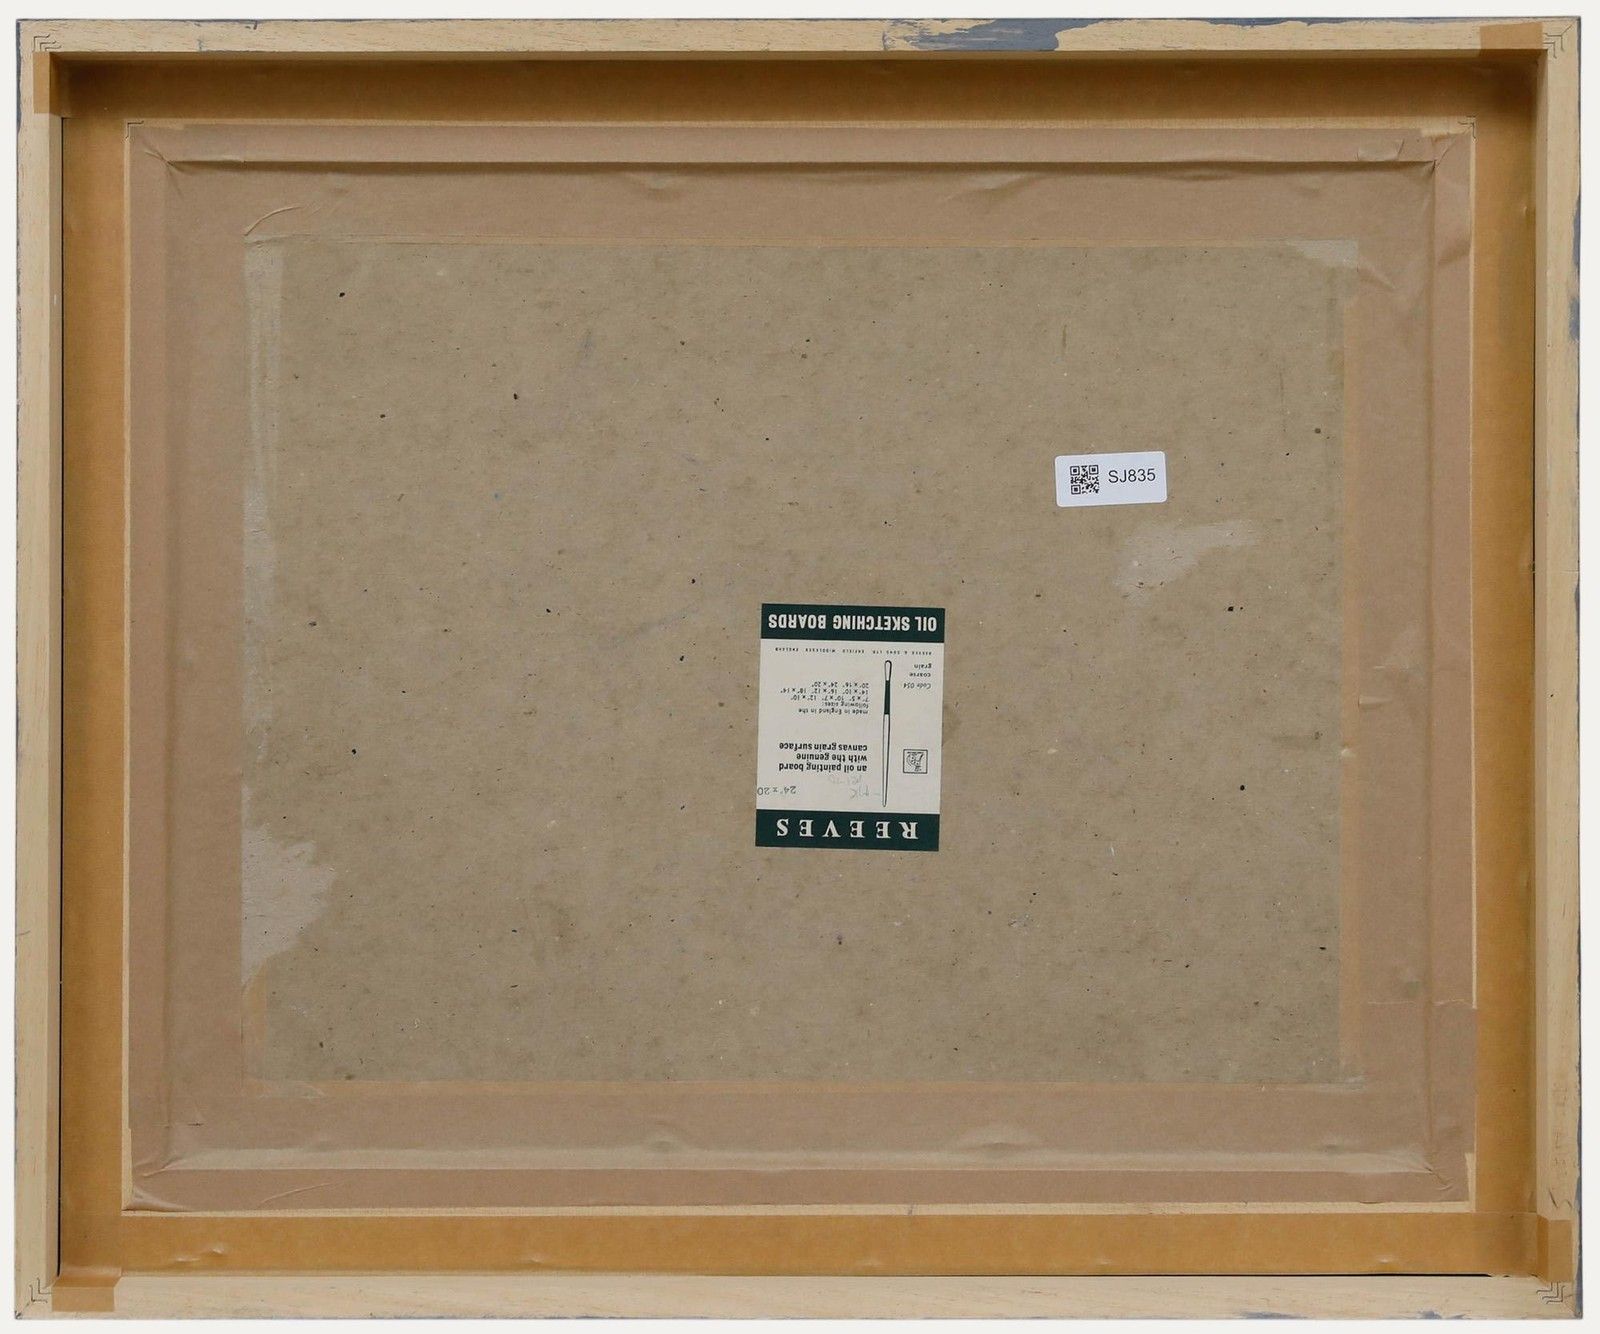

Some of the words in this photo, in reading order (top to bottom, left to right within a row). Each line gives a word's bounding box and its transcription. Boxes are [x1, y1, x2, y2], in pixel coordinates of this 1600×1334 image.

[1108, 468, 1156, 484] SJ835
[768, 614, 827, 630] BOARDS
[832, 614, 910, 631] SKETCHING
[914, 616, 937, 632] OIL
[840, 701, 869, 709] following
[818, 707, 842, 715] England
[779, 743, 813, 751] surface
[814, 742, 837, 752] grain
[838, 744, 868, 752] canvas
[796, 752, 830, 761] genuine
[831, 754, 846, 762] the
[848, 754, 867, 763] with
[778, 763, 804, 772] board
[806, 762, 841, 772] painting
[844, 765, 854, 773] oil
[776, 818, 918, 839] REEVES
